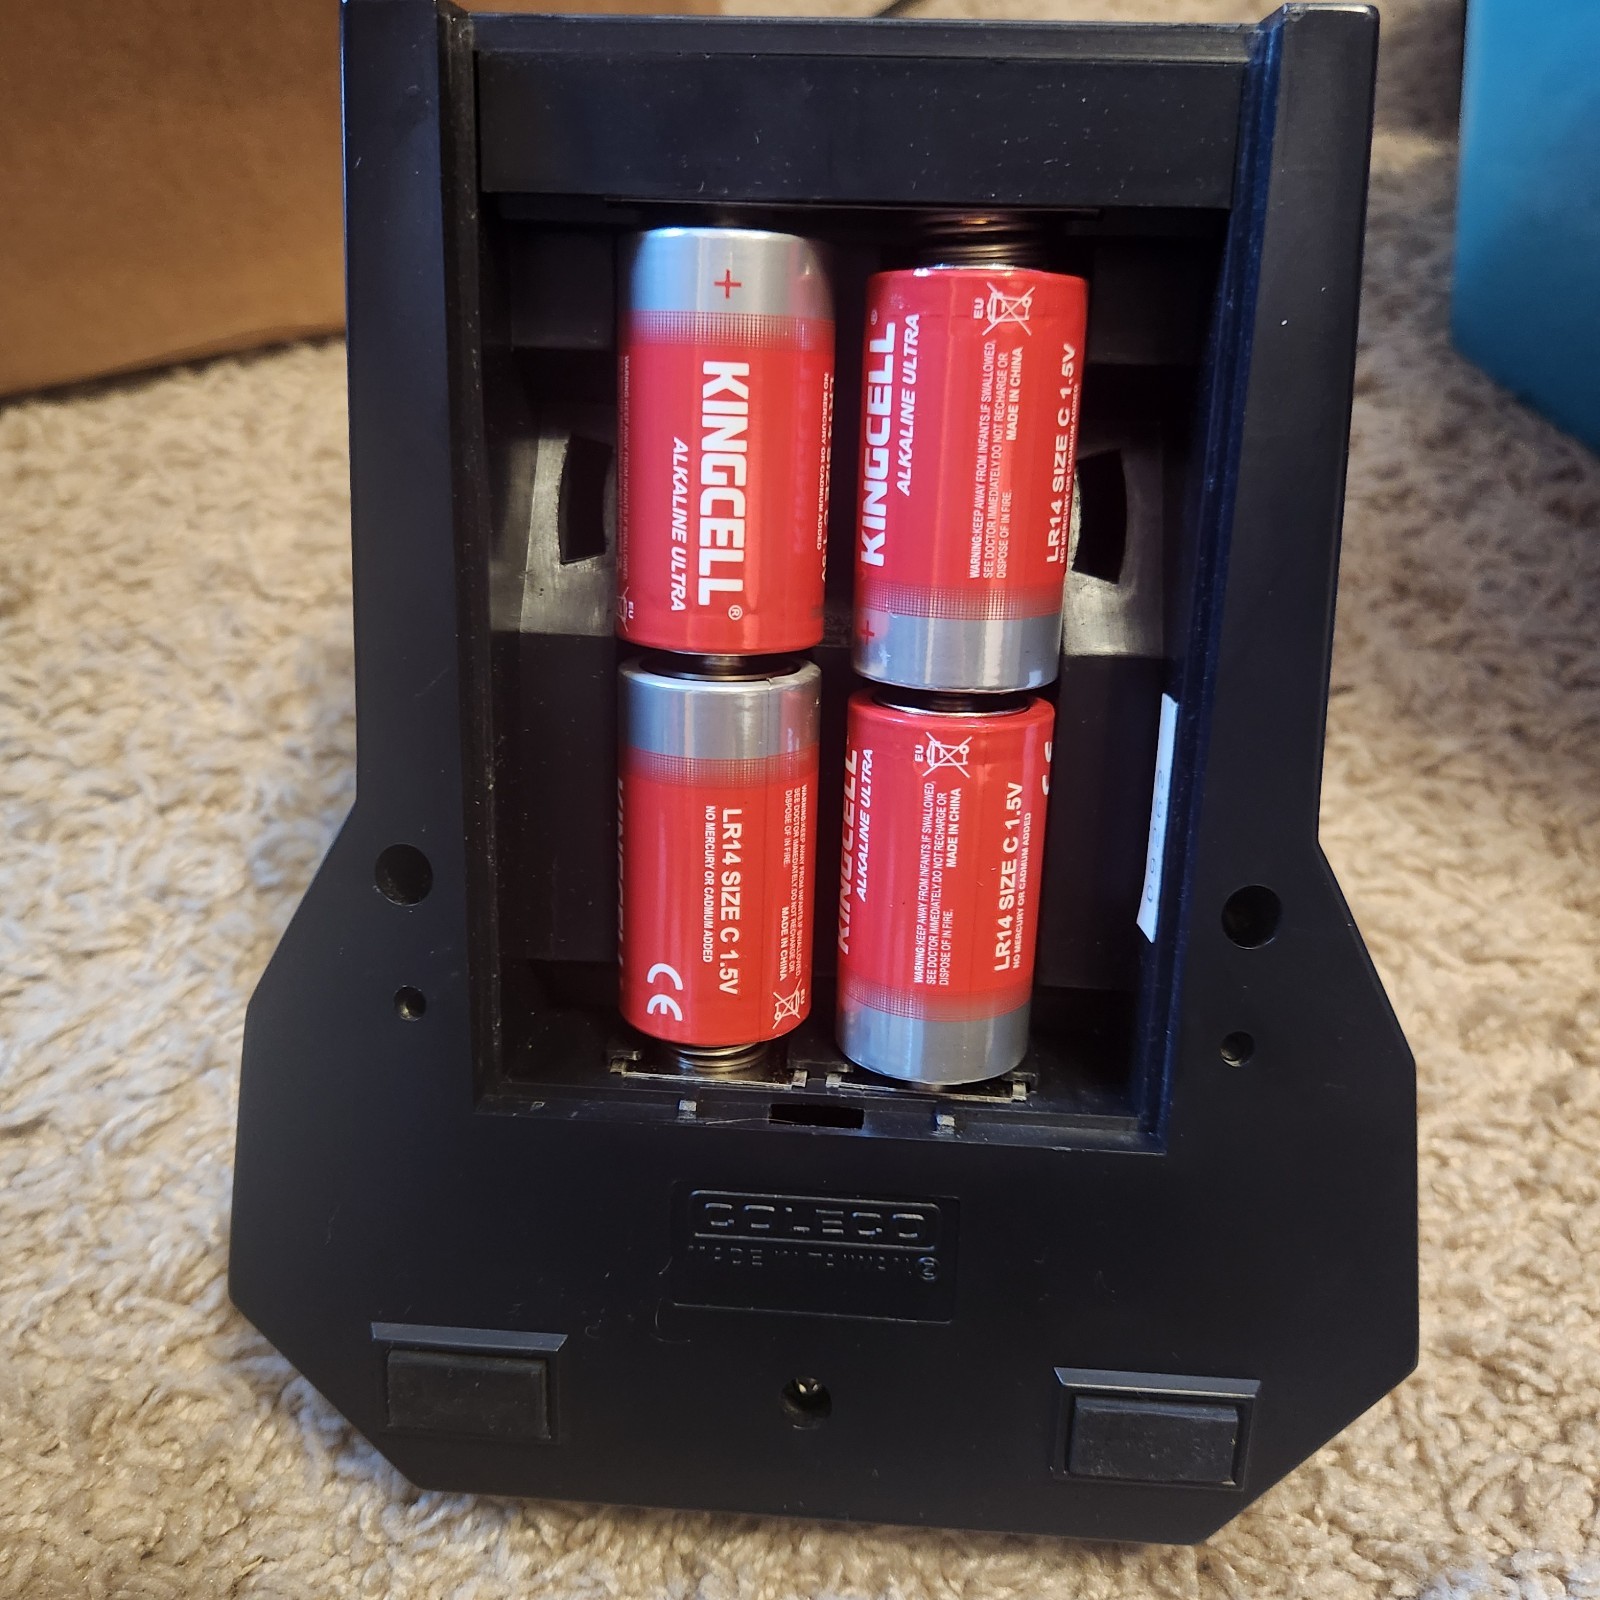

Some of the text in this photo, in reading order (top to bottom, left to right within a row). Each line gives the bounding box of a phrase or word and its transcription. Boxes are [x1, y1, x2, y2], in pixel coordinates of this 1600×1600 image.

[973, 297, 985, 320] EU
[998, 352, 1008, 368] OR
[823, 373, 829, 389] NO
[1006, 346, 1023, 440] MADE IN CHINA
[896, 314, 919, 496] ALKALINE ULTRA
[994, 369, 1007, 421] RECHARGE
[820, 392, 828, 444] MERCURY
[861, 322, 896, 567] KINGCELL
[993, 424, 1003, 443] NOT
[820, 447, 826, 462] OR
[1046, 342, 1076, 563] LR14 SIZE C 1.5V
[976, 455, 987, 482] FROM
[698, 361, 750, 605] KINGCELL
[974, 483, 985, 509] AWAY
[670, 437, 688, 611] ALKALINE ULTRA
[816, 514, 824, 550] ADDED
[999, 525, 1009, 538] OF
[1001, 514, 1010, 523] IN
[984, 520, 996, 559] DOCTOR
[983, 561, 994, 578] SEE
[997, 540, 1008, 578] DISPOSE
[628, 601, 634, 619] EU
[914, 745, 924, 762] EU
[784, 790, 793, 824] DISPOSE
[937, 792, 947, 805] OR
[784, 826, 791, 836] OF
[856, 749, 873, 902] ALKALINE ULTRA
[934, 806, 947, 851] RECHARGE
[946, 788, 961, 867] MADE IN CHINA
[784, 838, 791, 846] IN
[933, 851, 944, 869] NOT
[702, 805, 716, 962] NO MERCURY OR CADMUM ADDED
[918, 878, 928, 900] FROM
[994, 782, 1023, 971] LR14 SIZE C 1.5V
[718, 808, 742, 995] LR14 SIZE C 1.5V
[1013, 812, 1032, 969] NO MERCURY OR CADMUM ADDED
[917, 902, 927, 924] AWAY
[780, 907, 789, 981] MADE IN CHINA
[941, 940, 951, 950] OF
[942, 930, 952, 938] IN
[927, 936, 939, 968] DOCTOR
[789, 961, 795, 973] OR
[926, 970, 936, 984] SEE
[939, 952, 951, 985] DISPOSE
[800, 989, 805, 1005] EU
